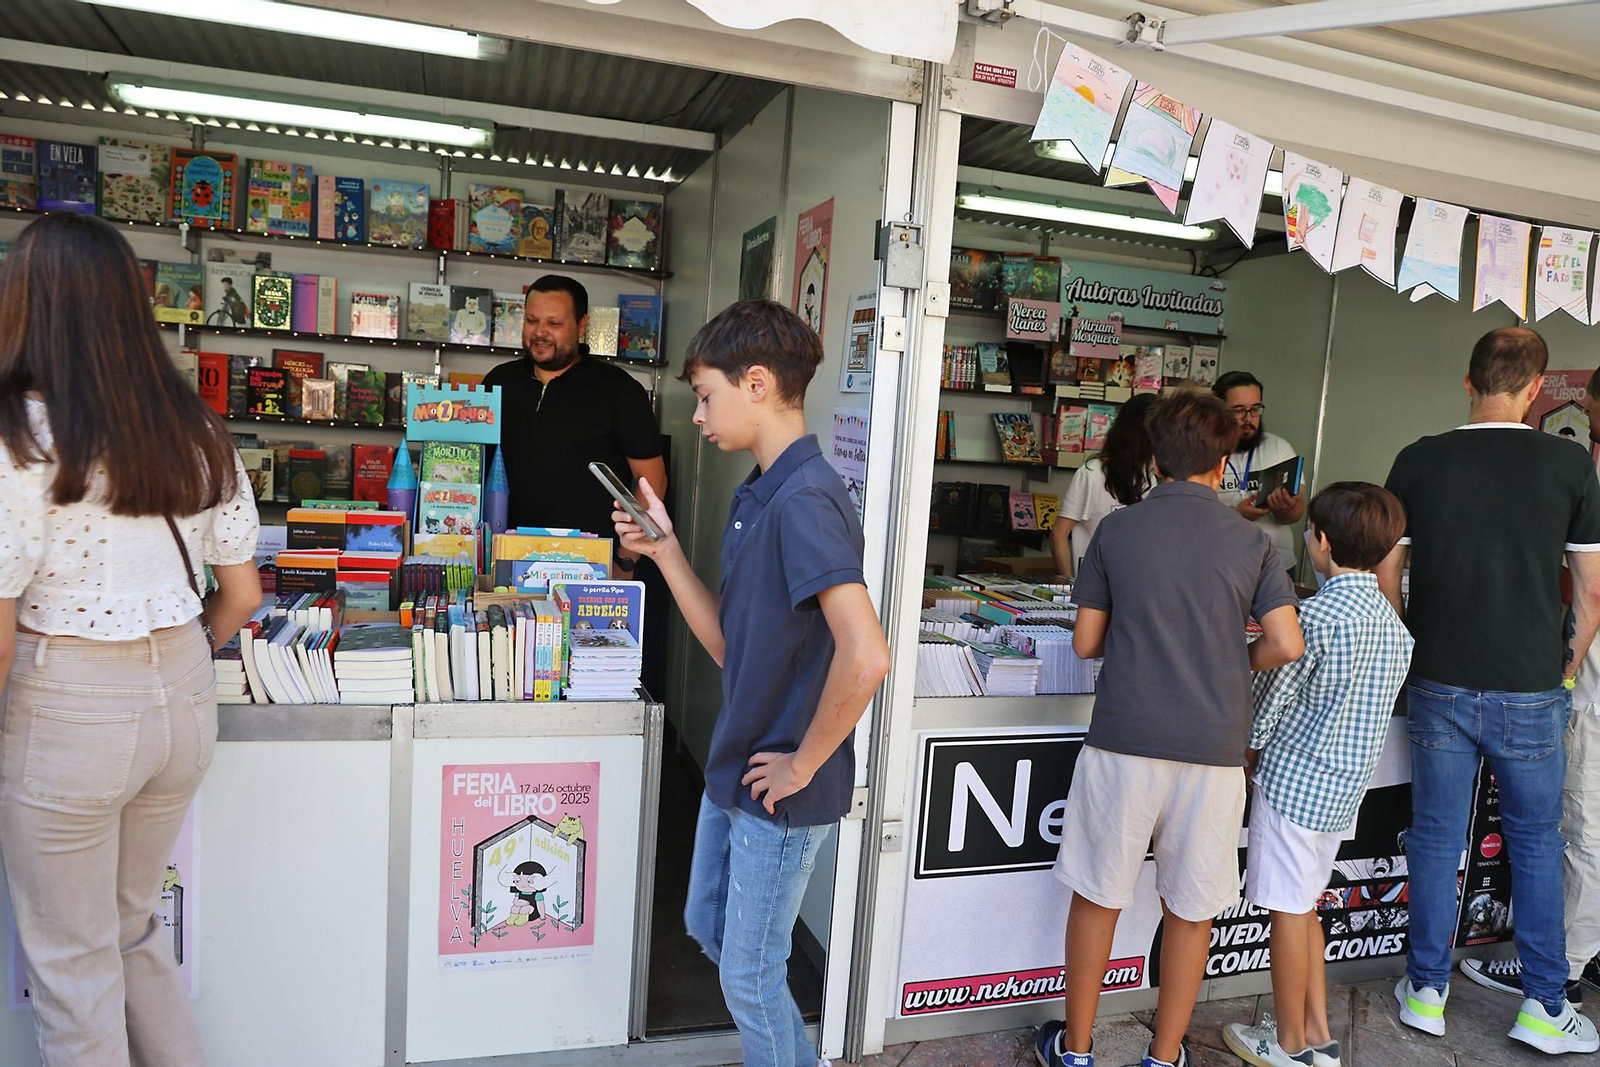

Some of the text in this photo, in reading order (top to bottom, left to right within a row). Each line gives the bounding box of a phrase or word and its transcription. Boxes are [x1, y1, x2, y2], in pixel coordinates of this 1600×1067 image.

[51, 144, 84, 165] EN VELA
[271, 190, 289, 199] SER
[270, 220, 308, 232] ARTISTA
[952, 254, 969, 264] EAM
[1546, 270, 1570, 283] FARO
[354, 296, 379, 304] KARL
[1065, 277, 1224, 317] Autoras Invitadas
[1011, 302, 1047, 320] Nerea
[1009, 316, 1047, 334] Llanes
[1078, 319, 1115, 334] Miriam
[1071, 329, 1120, 347] Mosquera
[250, 370, 283, 378] TENSIÓN
[1542, 374, 1568, 387] ERIA
[250, 380, 285, 389] ROTURA
[1553, 387, 1586, 400] LIBRO
[432, 445, 472, 460] MORTINA
[530, 571, 594, 580] Mis primeras
[610, 586, 625, 594] Pipa
[577, 604, 629, 618] ABUELOS
[453, 772, 517, 796] FERIA
[519, 782, 592, 794] 17 al 26 octubre
[474, 793, 557, 817] del LIBRO
[560, 792, 590, 805] 2025
[947, 758, 1068, 852] Ne
[534, 836, 570, 864] edición
[449, 817, 464, 943] HUELVA
[1209, 922, 1272, 949] OVEDA
